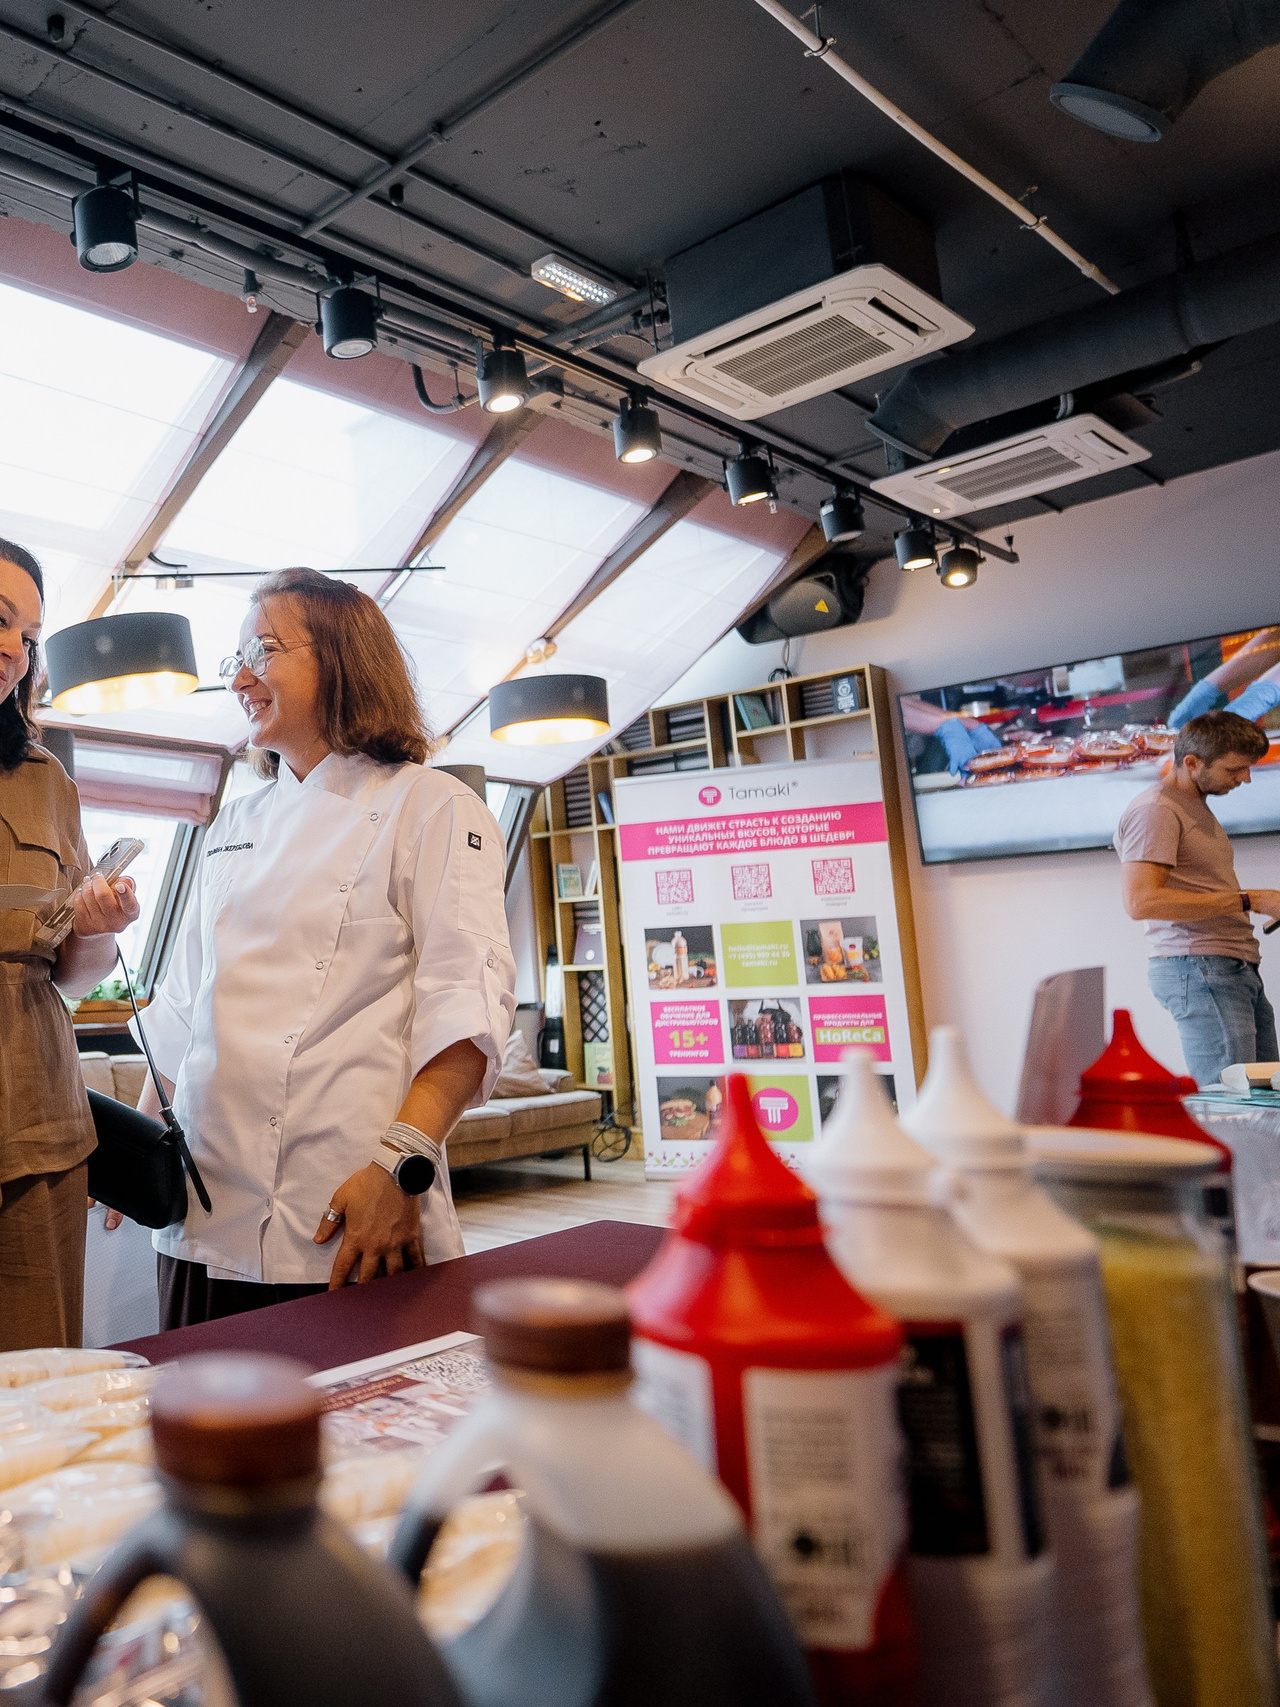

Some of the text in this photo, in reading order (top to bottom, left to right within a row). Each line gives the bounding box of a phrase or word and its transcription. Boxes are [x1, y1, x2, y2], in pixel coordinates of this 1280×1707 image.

[656, 811, 842, 836] НАМИ ДВИЖЕТ СТРАСТЬ К СОЗДАНИЮ
[668, 823, 829, 844] УНИКАЛЬНЫХ ВКУСОВ, КОТОРЫЕ
[647, 831, 855, 856] ПРЕВРАЩАЮТ КАЖДОЕ БЛЮДО В ШЕДЕВР!
[695, 1012, 711, 1020] ДЛЯ
[813, 1012, 883, 1020] ПРОФЕССИОНАЛЬНЫЕ
[860, 1019, 875, 1027] ДЛЯ
[669, 1030, 709, 1048] 15+
[819, 1029, 882, 1043] HoReCa
[669, 1050, 709, 1058] ТРЕНИНГОВ
